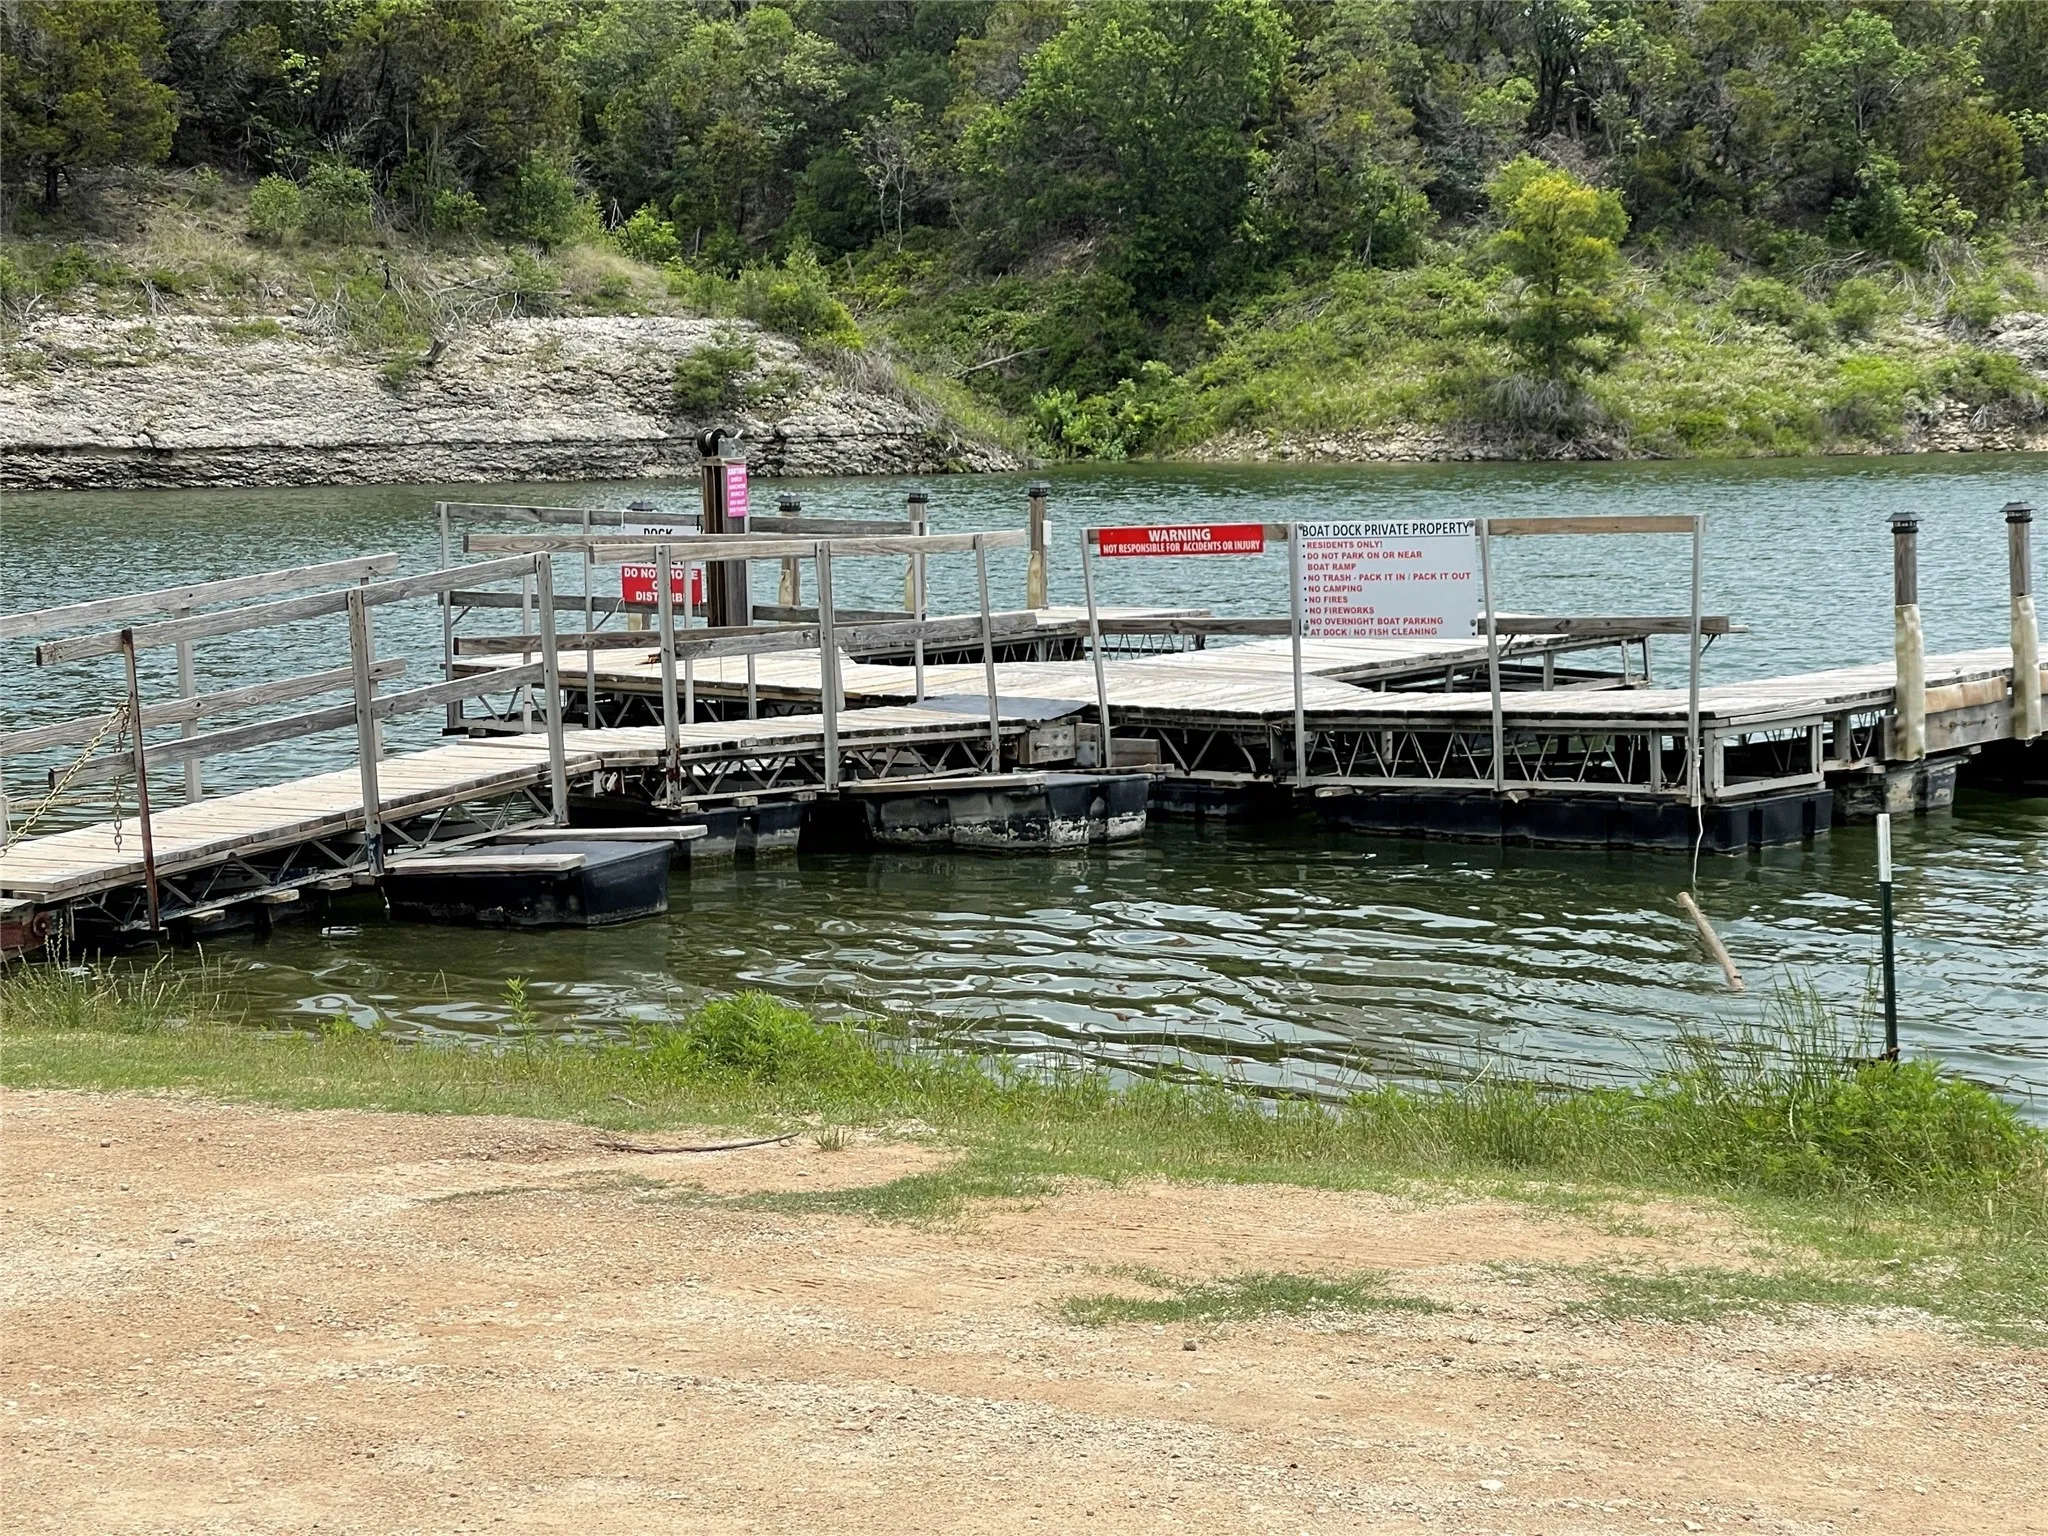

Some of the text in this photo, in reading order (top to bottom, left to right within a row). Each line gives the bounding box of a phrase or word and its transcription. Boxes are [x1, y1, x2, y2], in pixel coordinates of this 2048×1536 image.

[1148, 528, 1211, 542] WARNING
[1302, 522, 1469, 536] BOAT DOCK PRIVATE PROPERTY
[1103, 540, 1260, 554] NOT RESPONSIBLE FOR ACCIDENTS OR INJURY
[624, 568, 698, 580] DO NO OE
